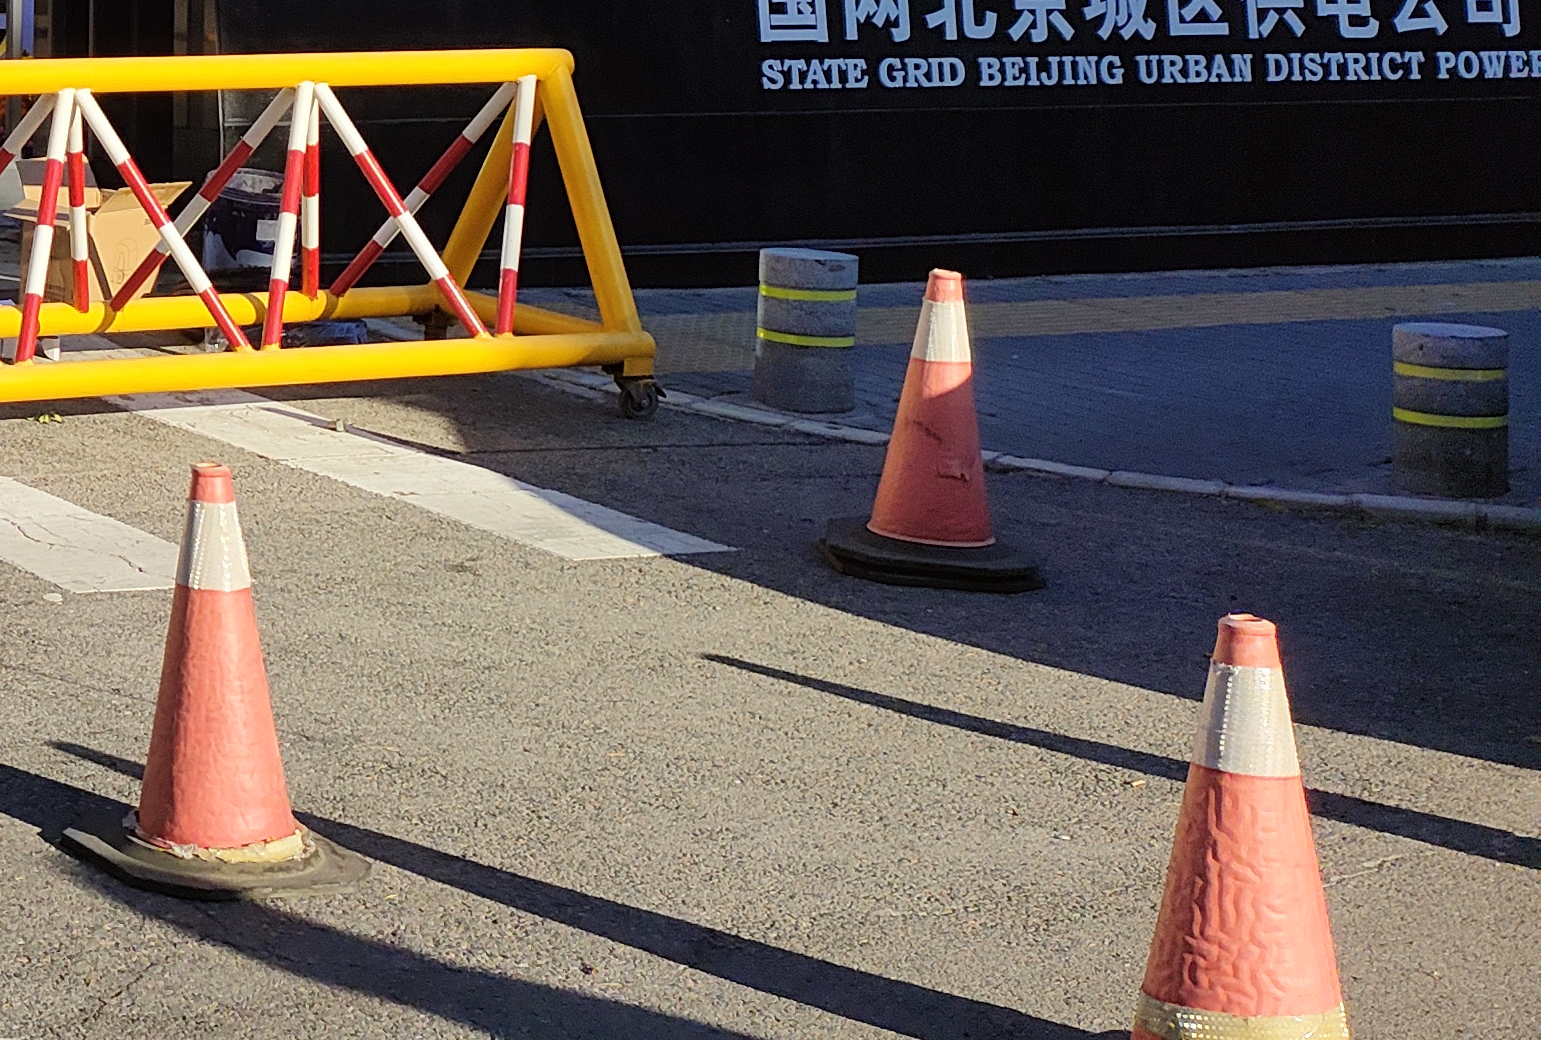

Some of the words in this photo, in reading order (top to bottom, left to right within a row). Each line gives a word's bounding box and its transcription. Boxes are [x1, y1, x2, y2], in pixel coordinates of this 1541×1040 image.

[761, 58, 869, 90] STATE
[879, 57, 966, 88] GRID
[979, 55, 1125, 87] BEIJING
[1134, 53, 1254, 84] URBAN
[1264, 50, 1425, 82] DISTRICT
